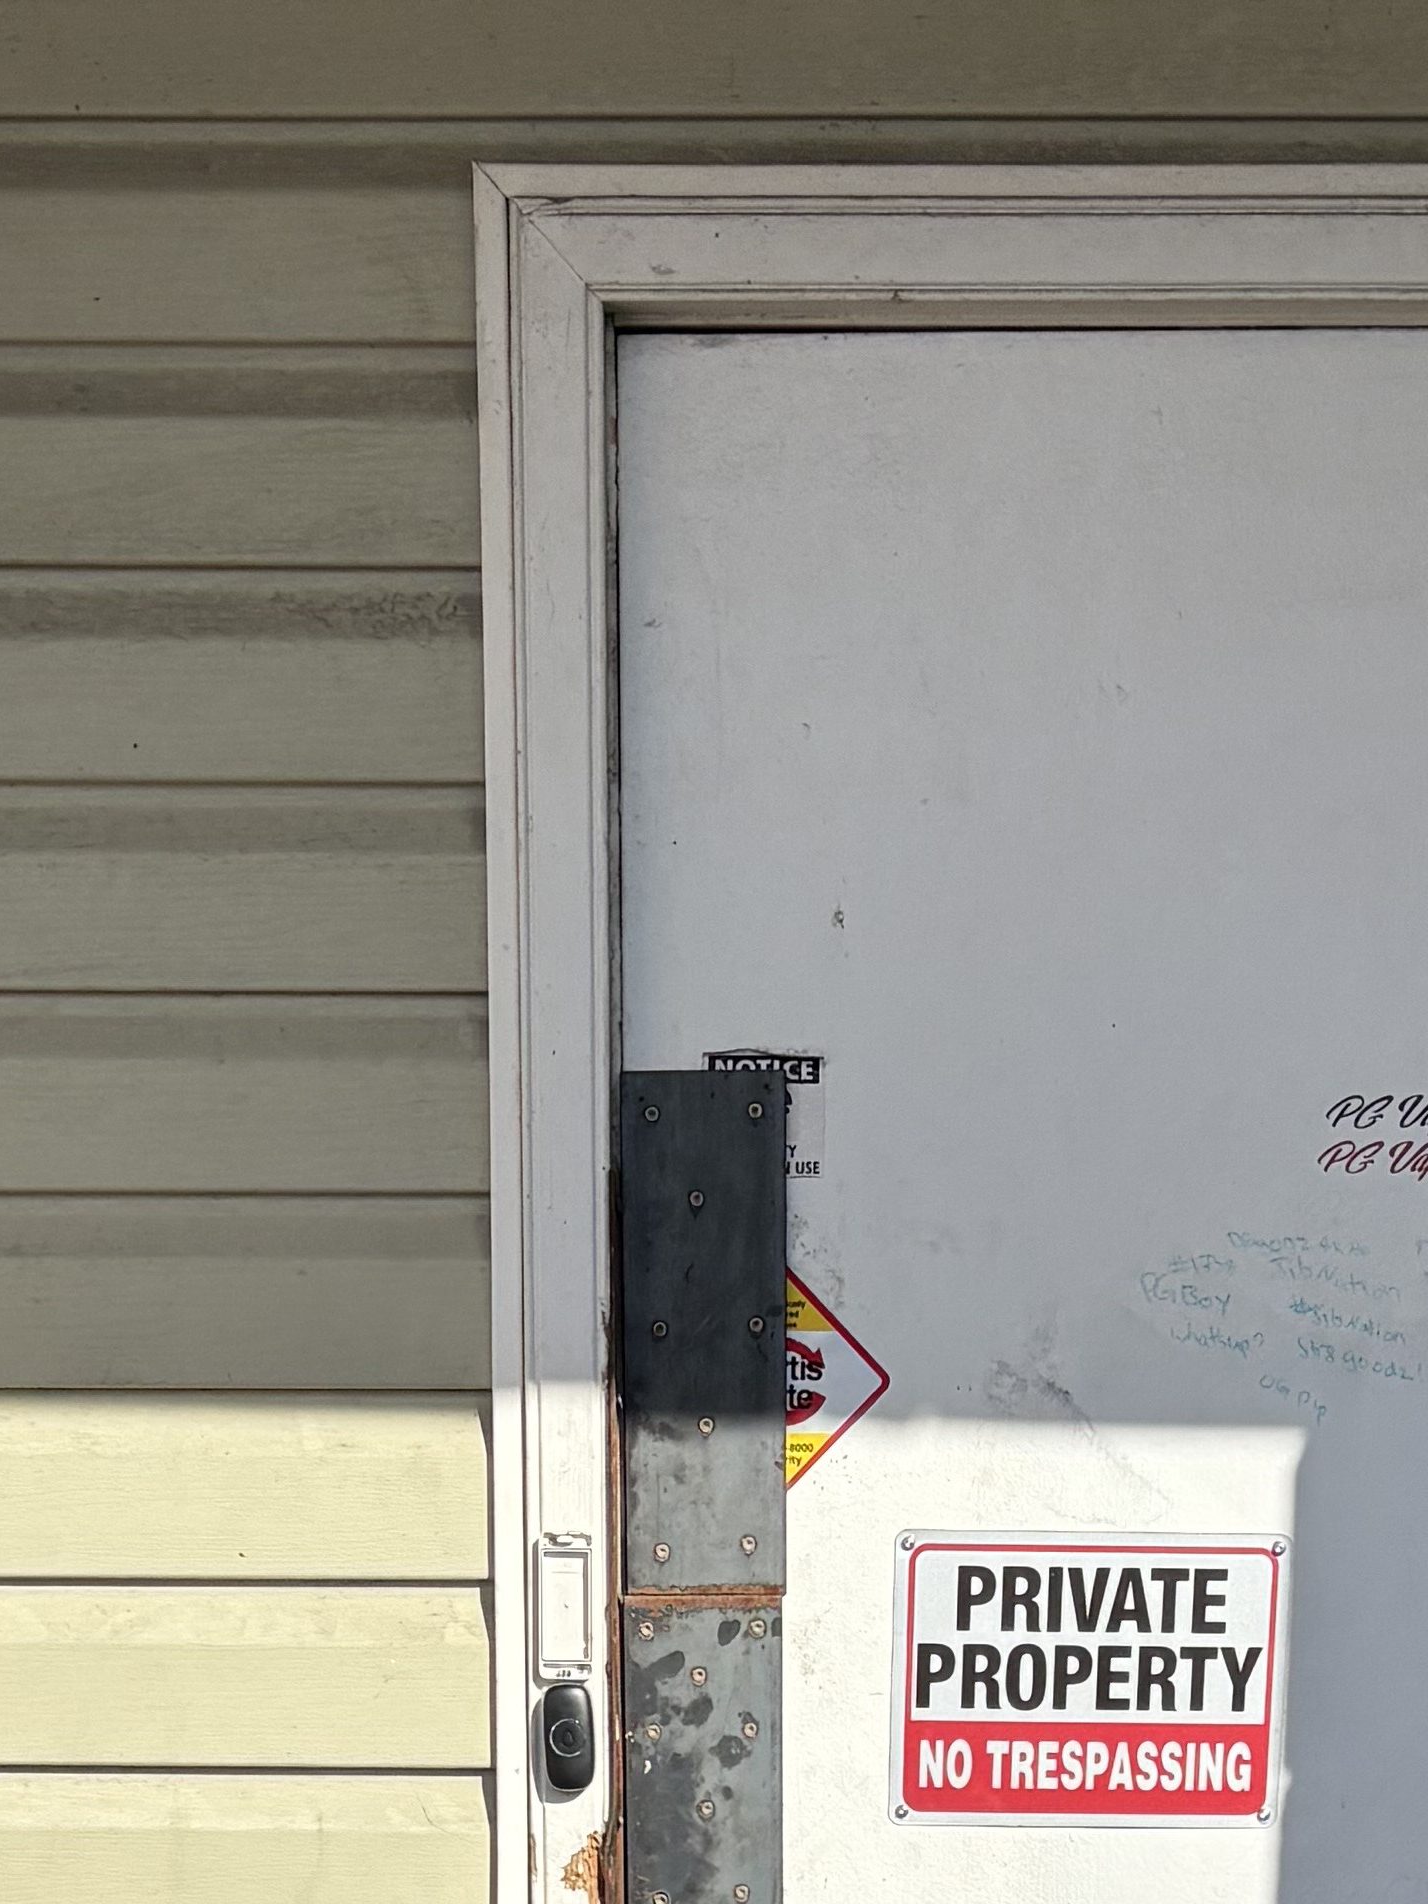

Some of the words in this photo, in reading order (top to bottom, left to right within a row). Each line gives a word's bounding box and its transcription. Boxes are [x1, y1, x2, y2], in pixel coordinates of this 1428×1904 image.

[1326, 1094, 1394, 1129] PG
[795, 1161, 820, 1175] USE
[1317, 1140, 1385, 1174] PG
[956, 1564, 1229, 1635] PRIVATE
[915, 1642, 1263, 1712] PROPERTY
[917, 1738, 972, 1790] NO
[985, 1739, 1253, 1793] TRESPASSING
